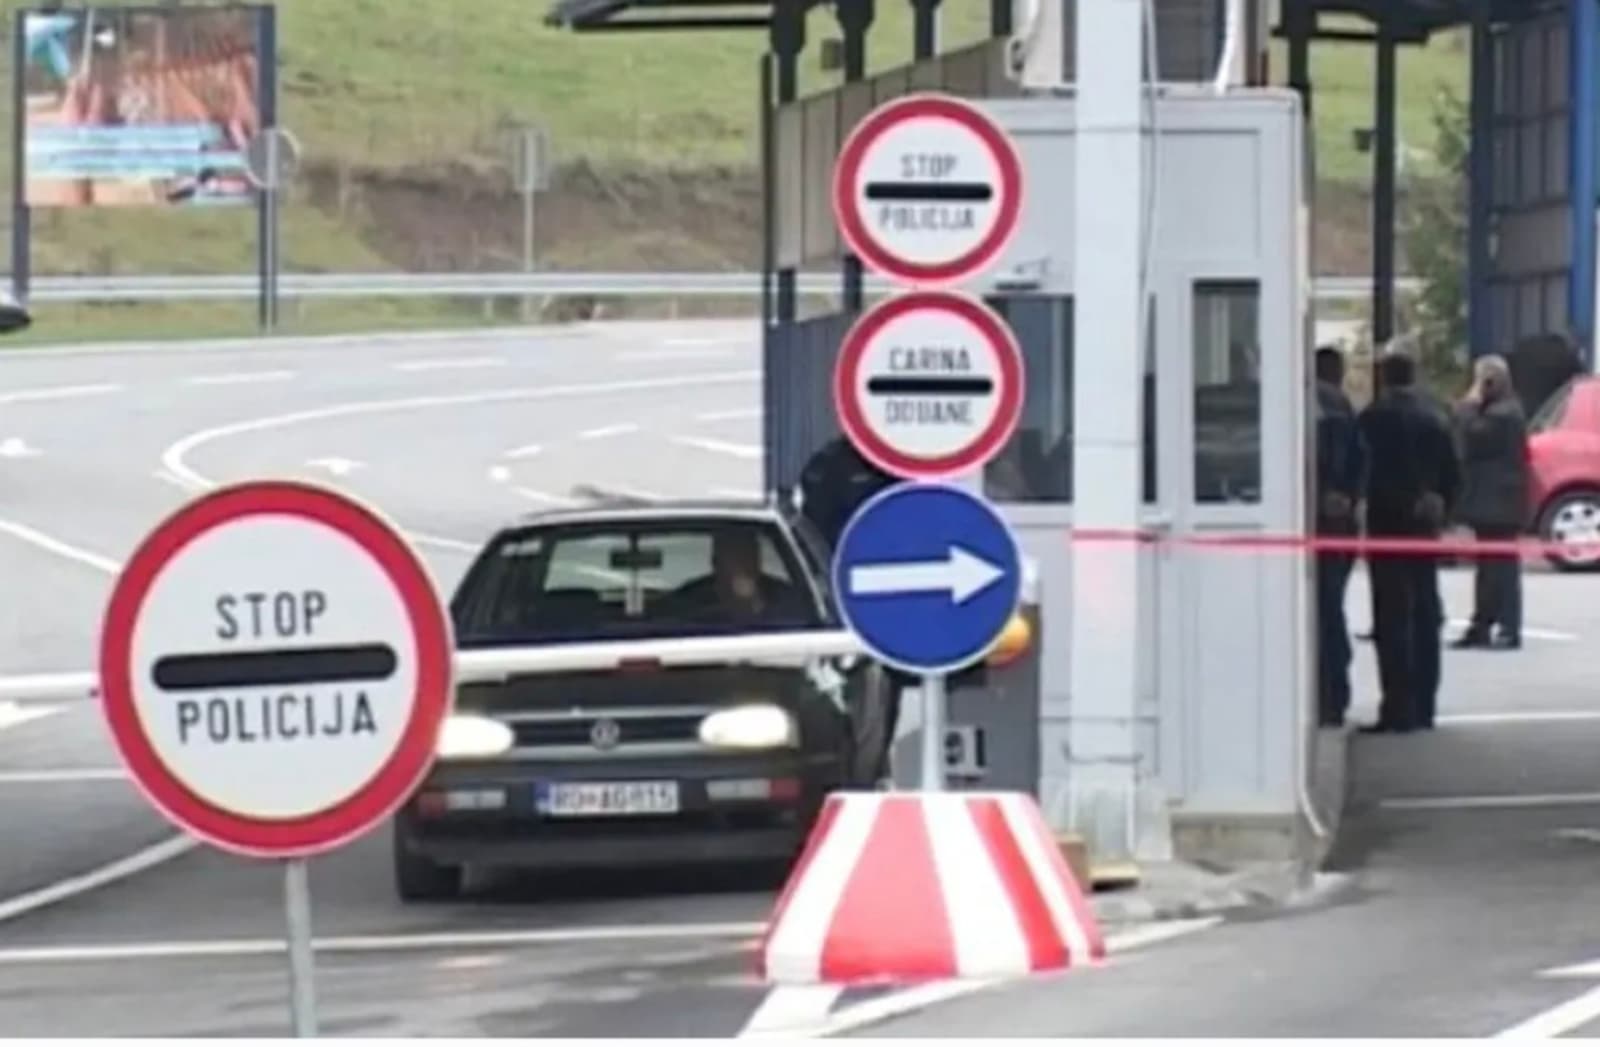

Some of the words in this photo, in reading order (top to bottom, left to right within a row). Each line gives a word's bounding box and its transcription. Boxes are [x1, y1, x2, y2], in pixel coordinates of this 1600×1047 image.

[901, 154, 957, 178] STOP
[879, 206, 974, 231] POLICIJA
[889, 347, 971, 371] CARINA
[886, 400, 973, 424] DOUANE
[215, 590, 327, 640] STOP
[176, 690, 378, 745] POLICIJA
